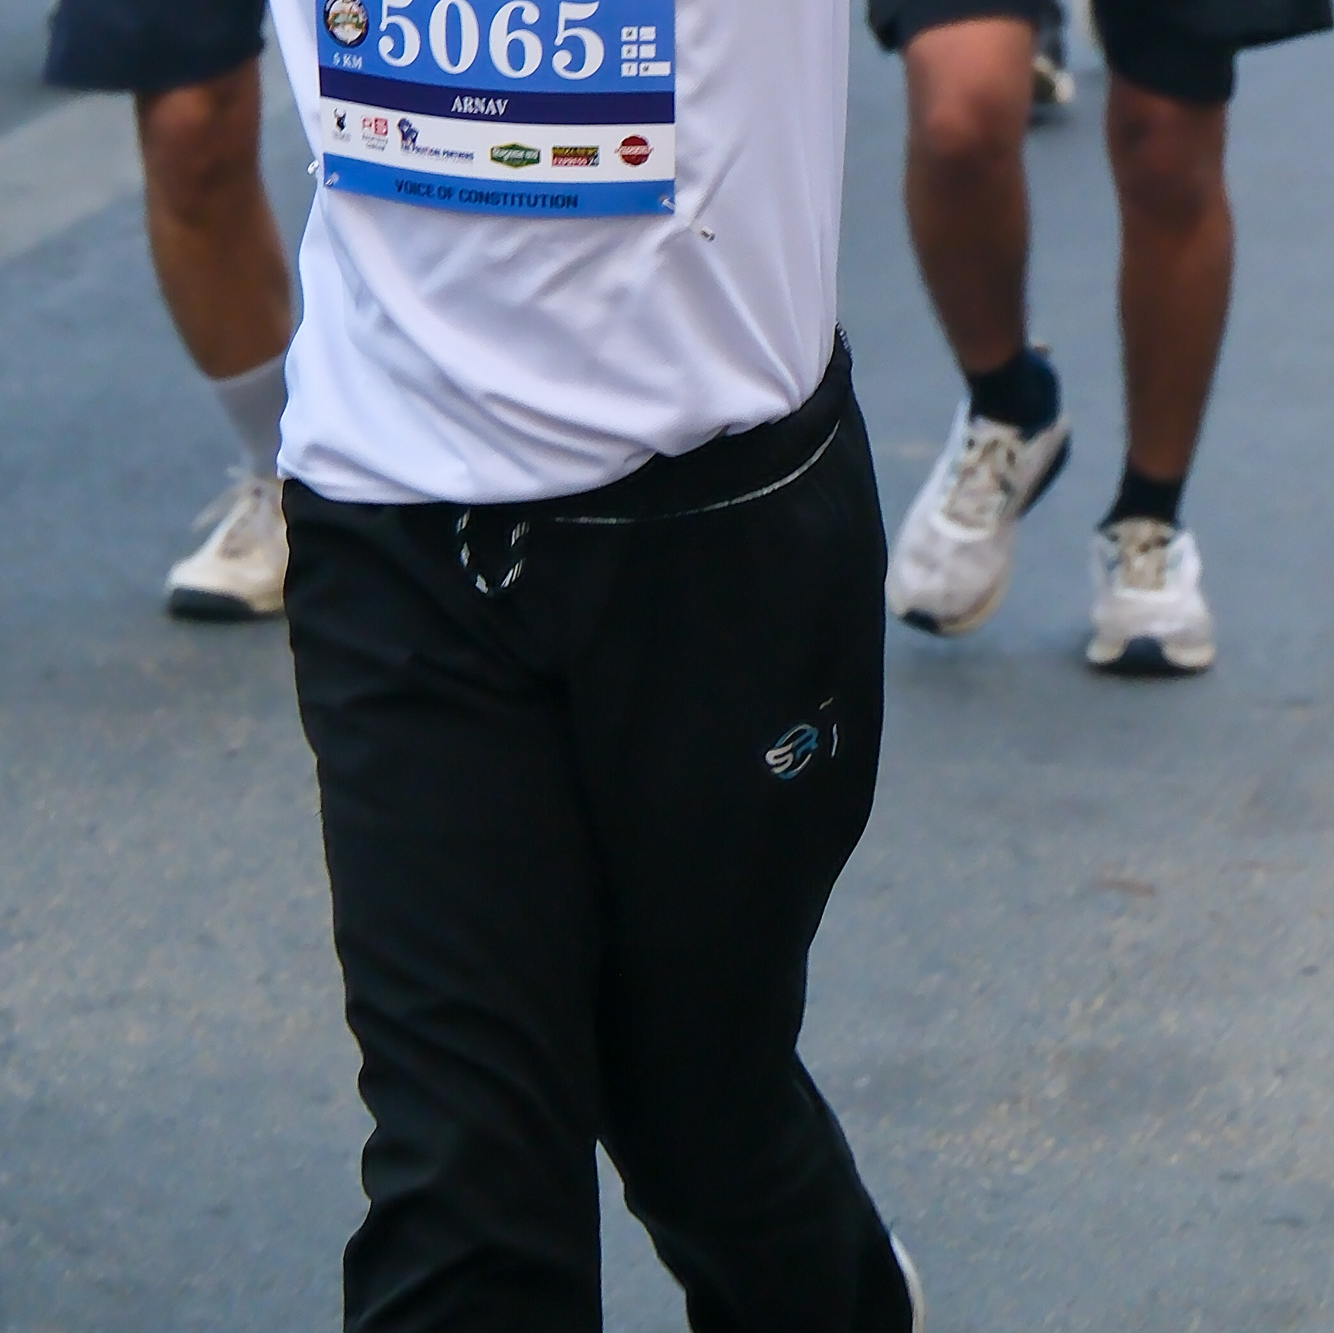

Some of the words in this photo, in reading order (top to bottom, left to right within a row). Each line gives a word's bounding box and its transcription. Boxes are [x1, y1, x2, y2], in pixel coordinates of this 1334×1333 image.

[342, 53, 363, 70] KM
[451, 95, 508, 117] ARNAV
[395, 178, 435, 200] VOICE
[436, 184, 455, 202] OF
[458, 188, 579, 210] CONSTITUTION
